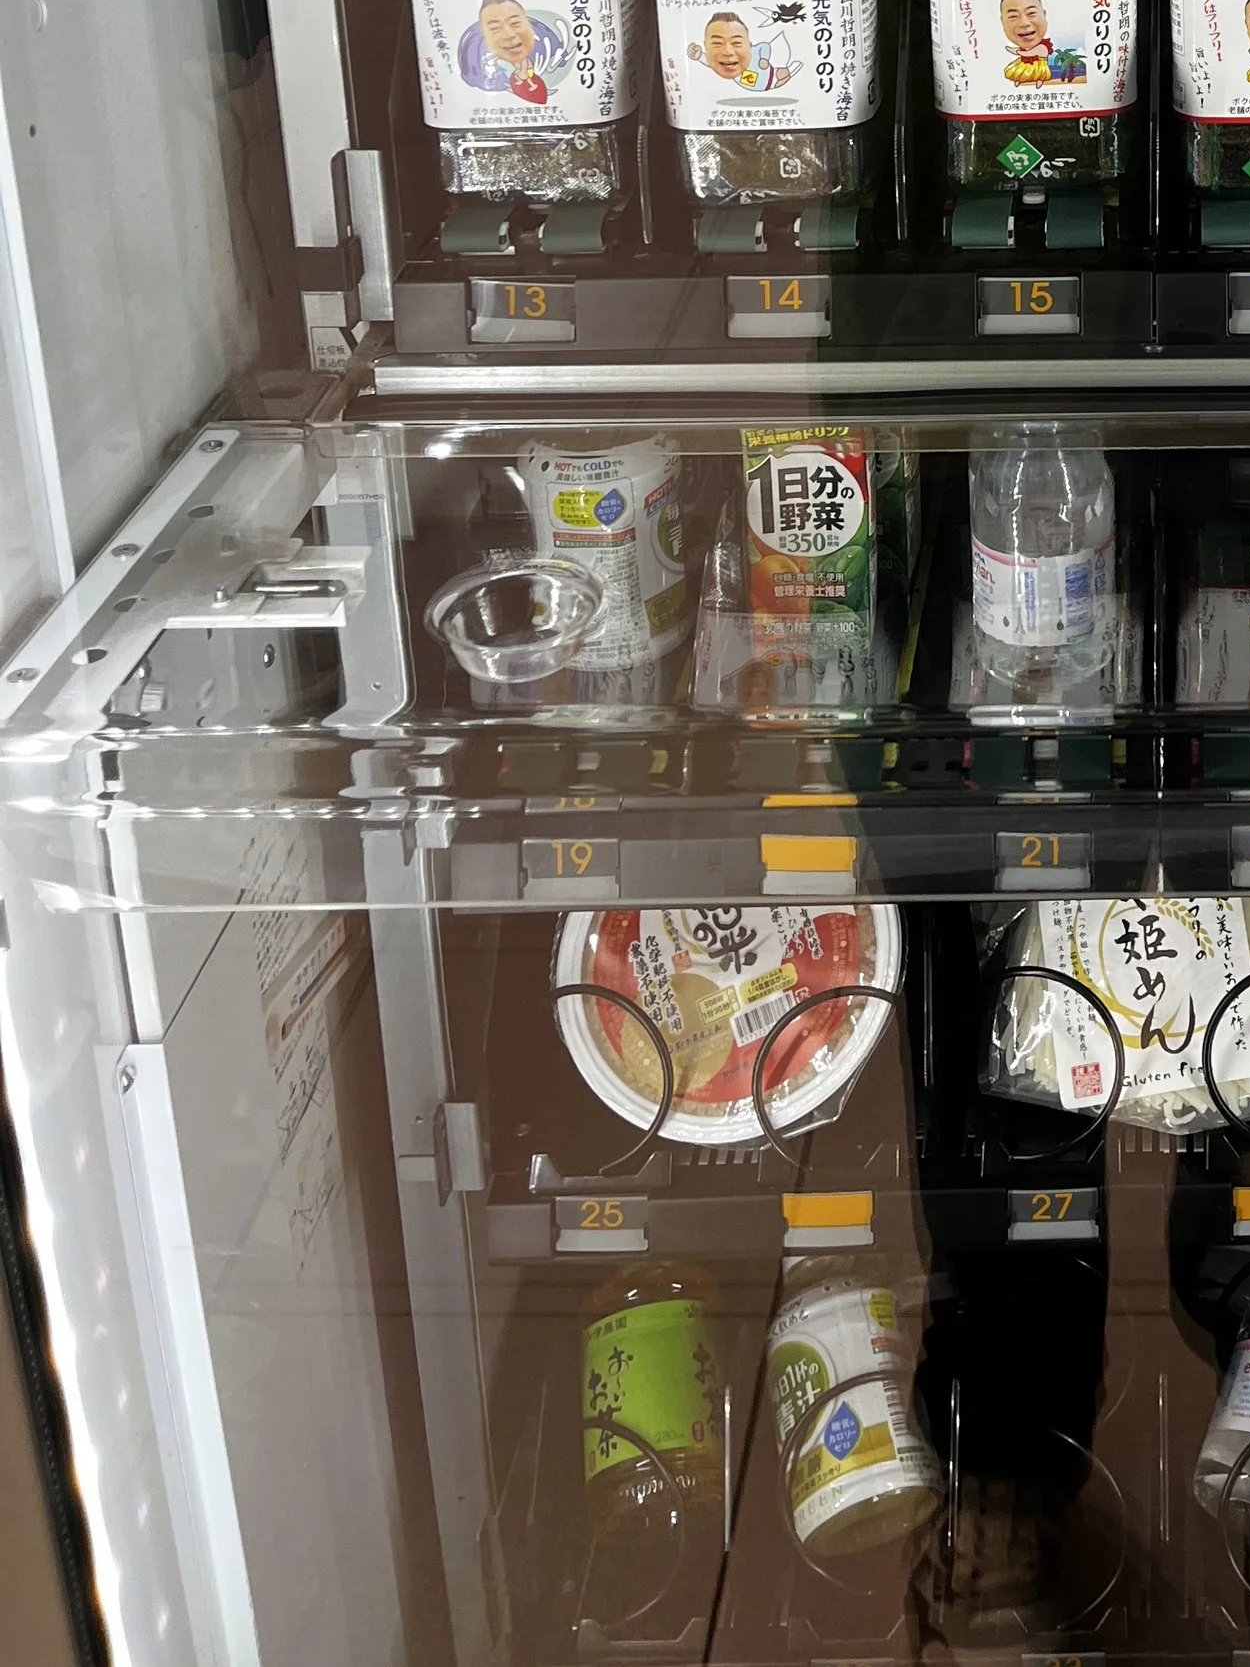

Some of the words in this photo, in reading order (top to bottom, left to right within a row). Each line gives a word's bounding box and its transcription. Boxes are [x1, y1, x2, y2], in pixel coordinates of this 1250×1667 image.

[987, 101, 1084, 111] 老舗の味をご賞味下さい。
[990, 92, 1080, 102] ボクの実家の海苔です。
[710, 109, 801, 119] ボクの実家の海苔です。
[504, 286, 546, 317] 13
[759, 280, 803, 311] 14
[1012, 282, 1054, 312] 15
[780, 502, 844, 532] 野菜
[552, 842, 594, 875] 19
[1020, 836, 1060, 867] 21
[1121, 1070, 1171, 1088] Gluten
[1178, 1061, 1206, 1078] fre
[580, 1200, 624, 1228] 25
[1031, 1193, 1073, 1220] 27
